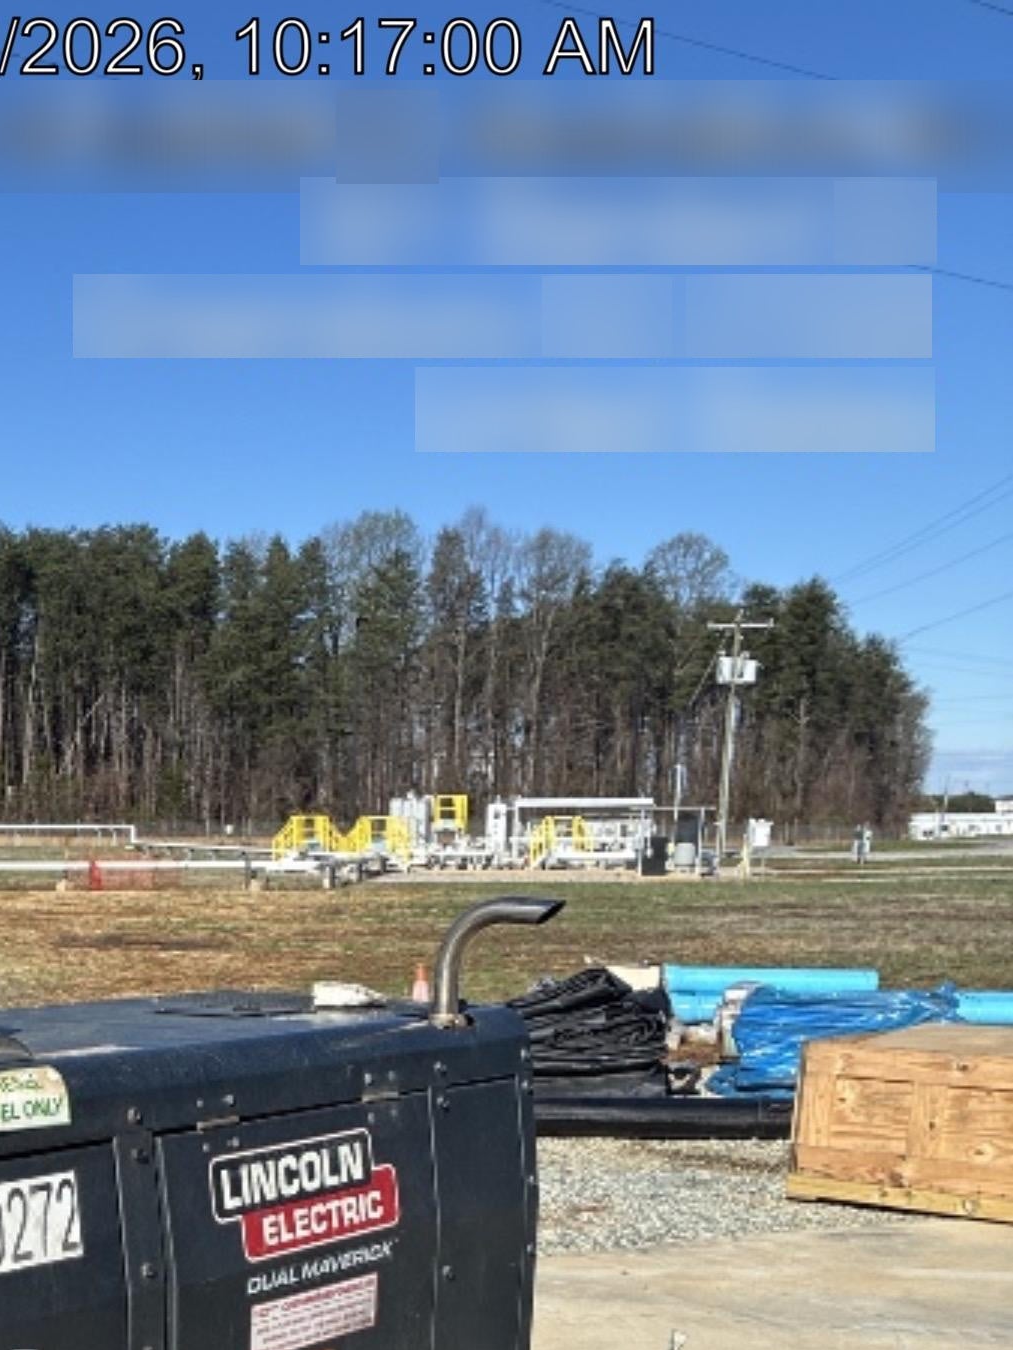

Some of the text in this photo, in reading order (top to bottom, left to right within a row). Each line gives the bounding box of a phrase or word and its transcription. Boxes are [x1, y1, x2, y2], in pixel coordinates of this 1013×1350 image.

[23, 1096, 63, 1117] ONLY
[220, 1142, 364, 1210] LINCOLN
[262, 1190, 384, 1246] ELECTRIC
[247, 1240, 394, 1295] DUAL MAVERICK
